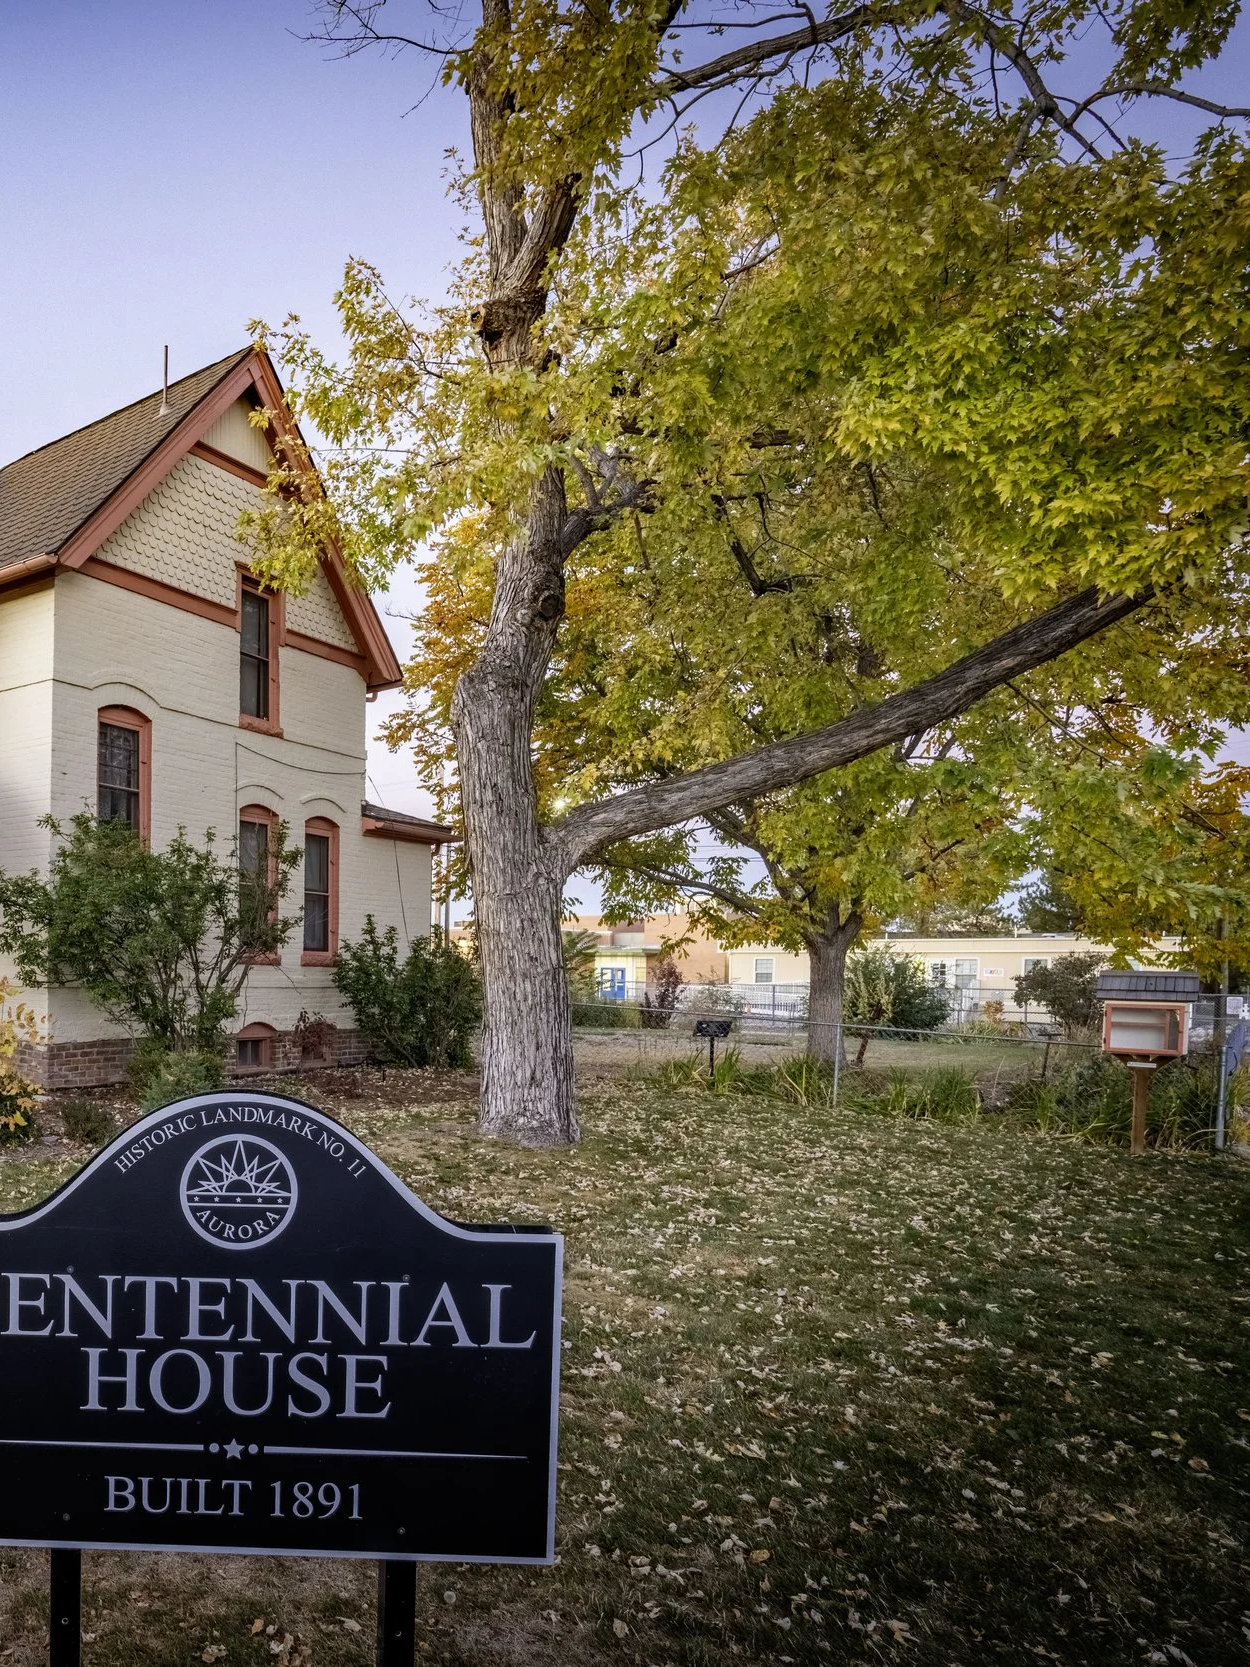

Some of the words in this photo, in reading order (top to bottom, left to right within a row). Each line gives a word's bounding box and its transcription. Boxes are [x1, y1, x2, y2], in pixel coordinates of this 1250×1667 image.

[114, 1114, 198, 1174] HISTORIC
[200, 1107, 319, 1141] LANDMARK
[316, 1131, 345, 1162] NO.
[346, 1158, 367, 1179] 11
[196, 1209, 280, 1240] AURORA
[80, 1348, 391, 1417] HOUSE
[104, 1476, 252, 1515] BUILT
[271, 1481, 362, 1518] 1891
